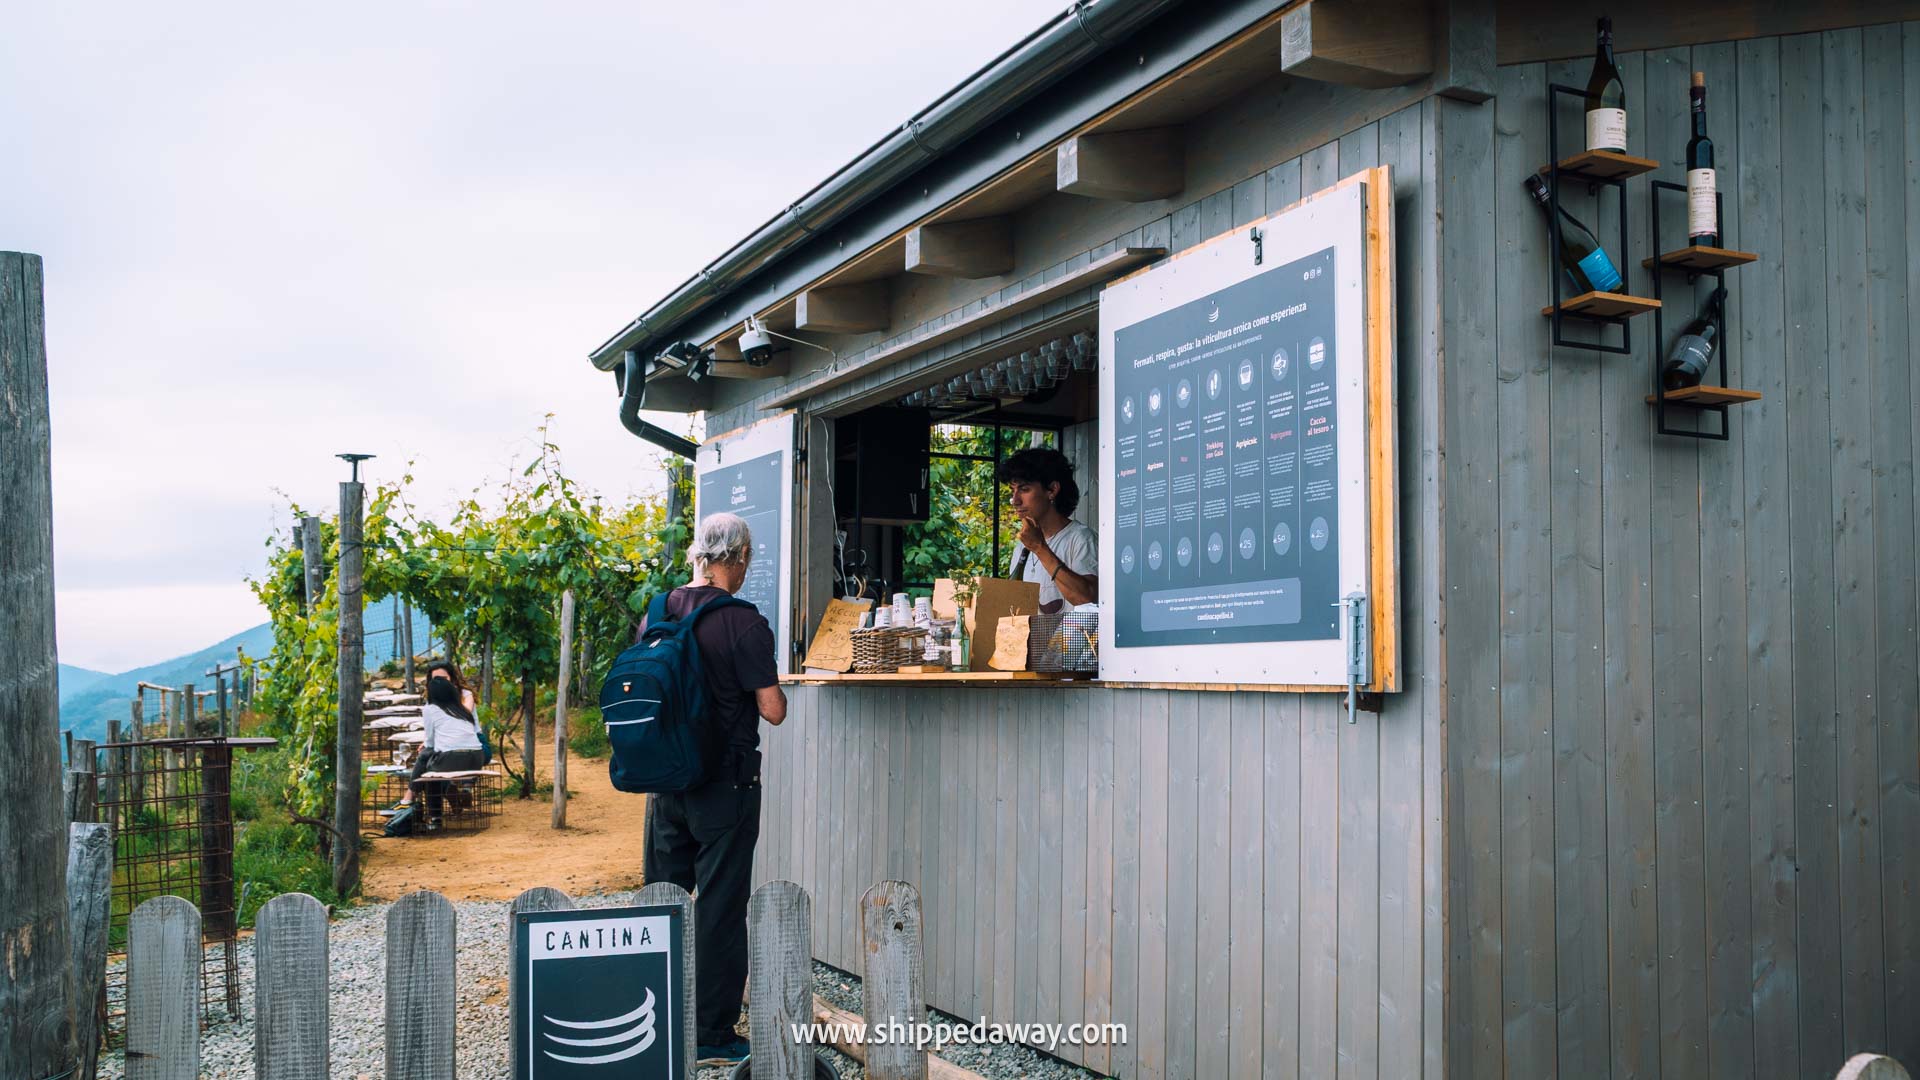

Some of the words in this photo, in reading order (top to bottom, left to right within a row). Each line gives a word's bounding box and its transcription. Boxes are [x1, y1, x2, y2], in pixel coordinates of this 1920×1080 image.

[1133, 353, 1155, 369] Fermati,
[1155, 347, 1176, 361] respira,
[1176, 341, 1195, 357] gusta:
[1195, 337, 1201, 348] la
[1202, 328, 1233, 346] viticultura
[1232, 321, 1252, 335] eroica
[1252, 315, 1270, 328] come
[1270, 302, 1307, 322] esperienza
[1309, 416, 1327, 426] Caccia
[1307, 428, 1313, 437] al
[1313, 425, 1330, 435] tesoro
[545, 926, 652, 951] CANTINA
